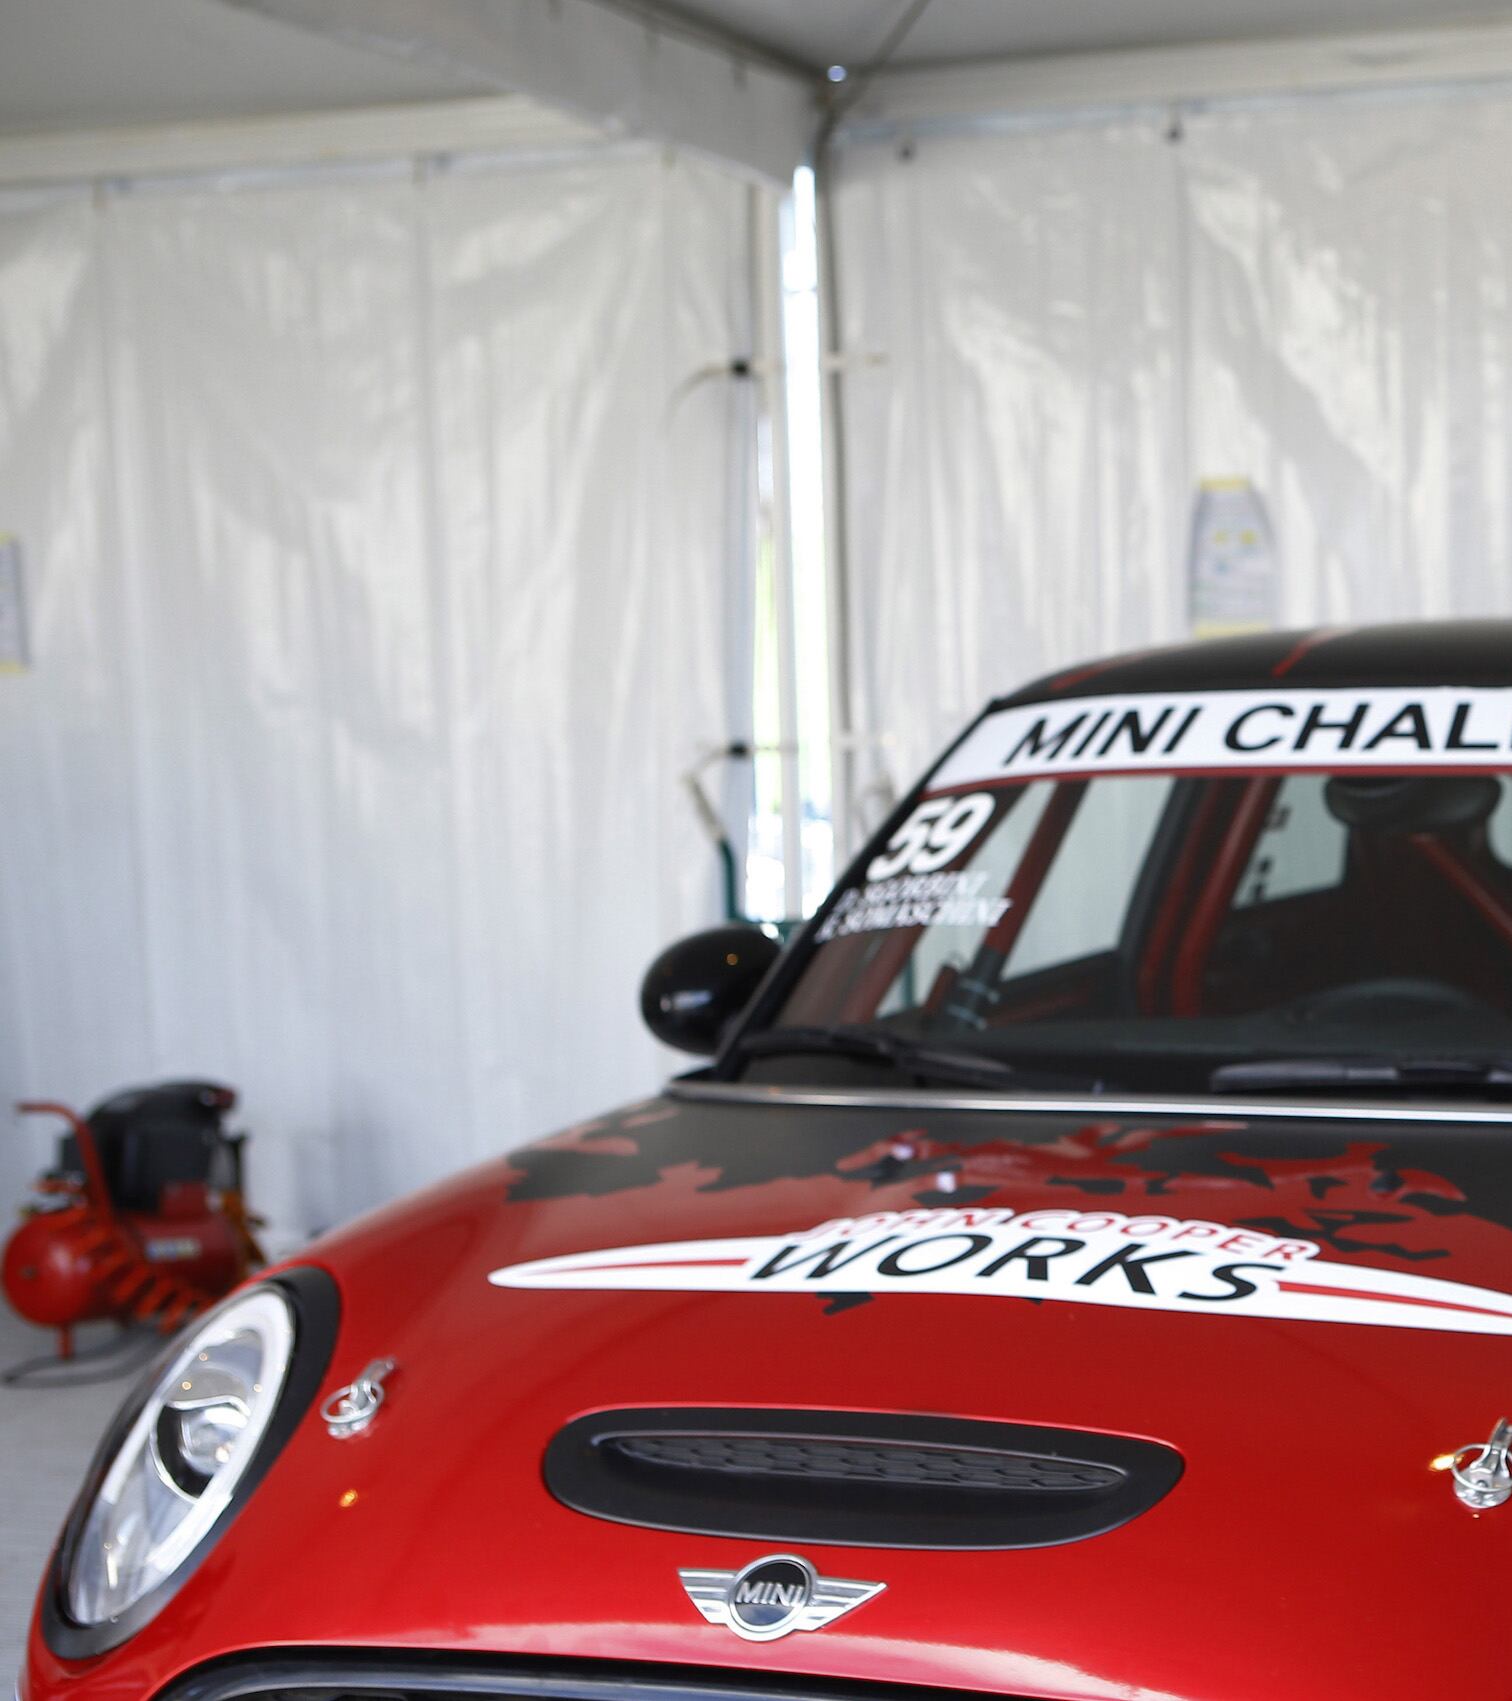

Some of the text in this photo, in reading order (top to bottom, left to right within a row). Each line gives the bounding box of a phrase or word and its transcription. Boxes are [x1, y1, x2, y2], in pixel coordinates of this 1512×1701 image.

[1002, 705, 1203, 768] MINI
[866, 792, 996, 882] 59
[751, 1233, 1286, 1302] WORKS
[1021, 1210, 1308, 1262] COOPER
[735, 1581, 804, 1608] MINI
